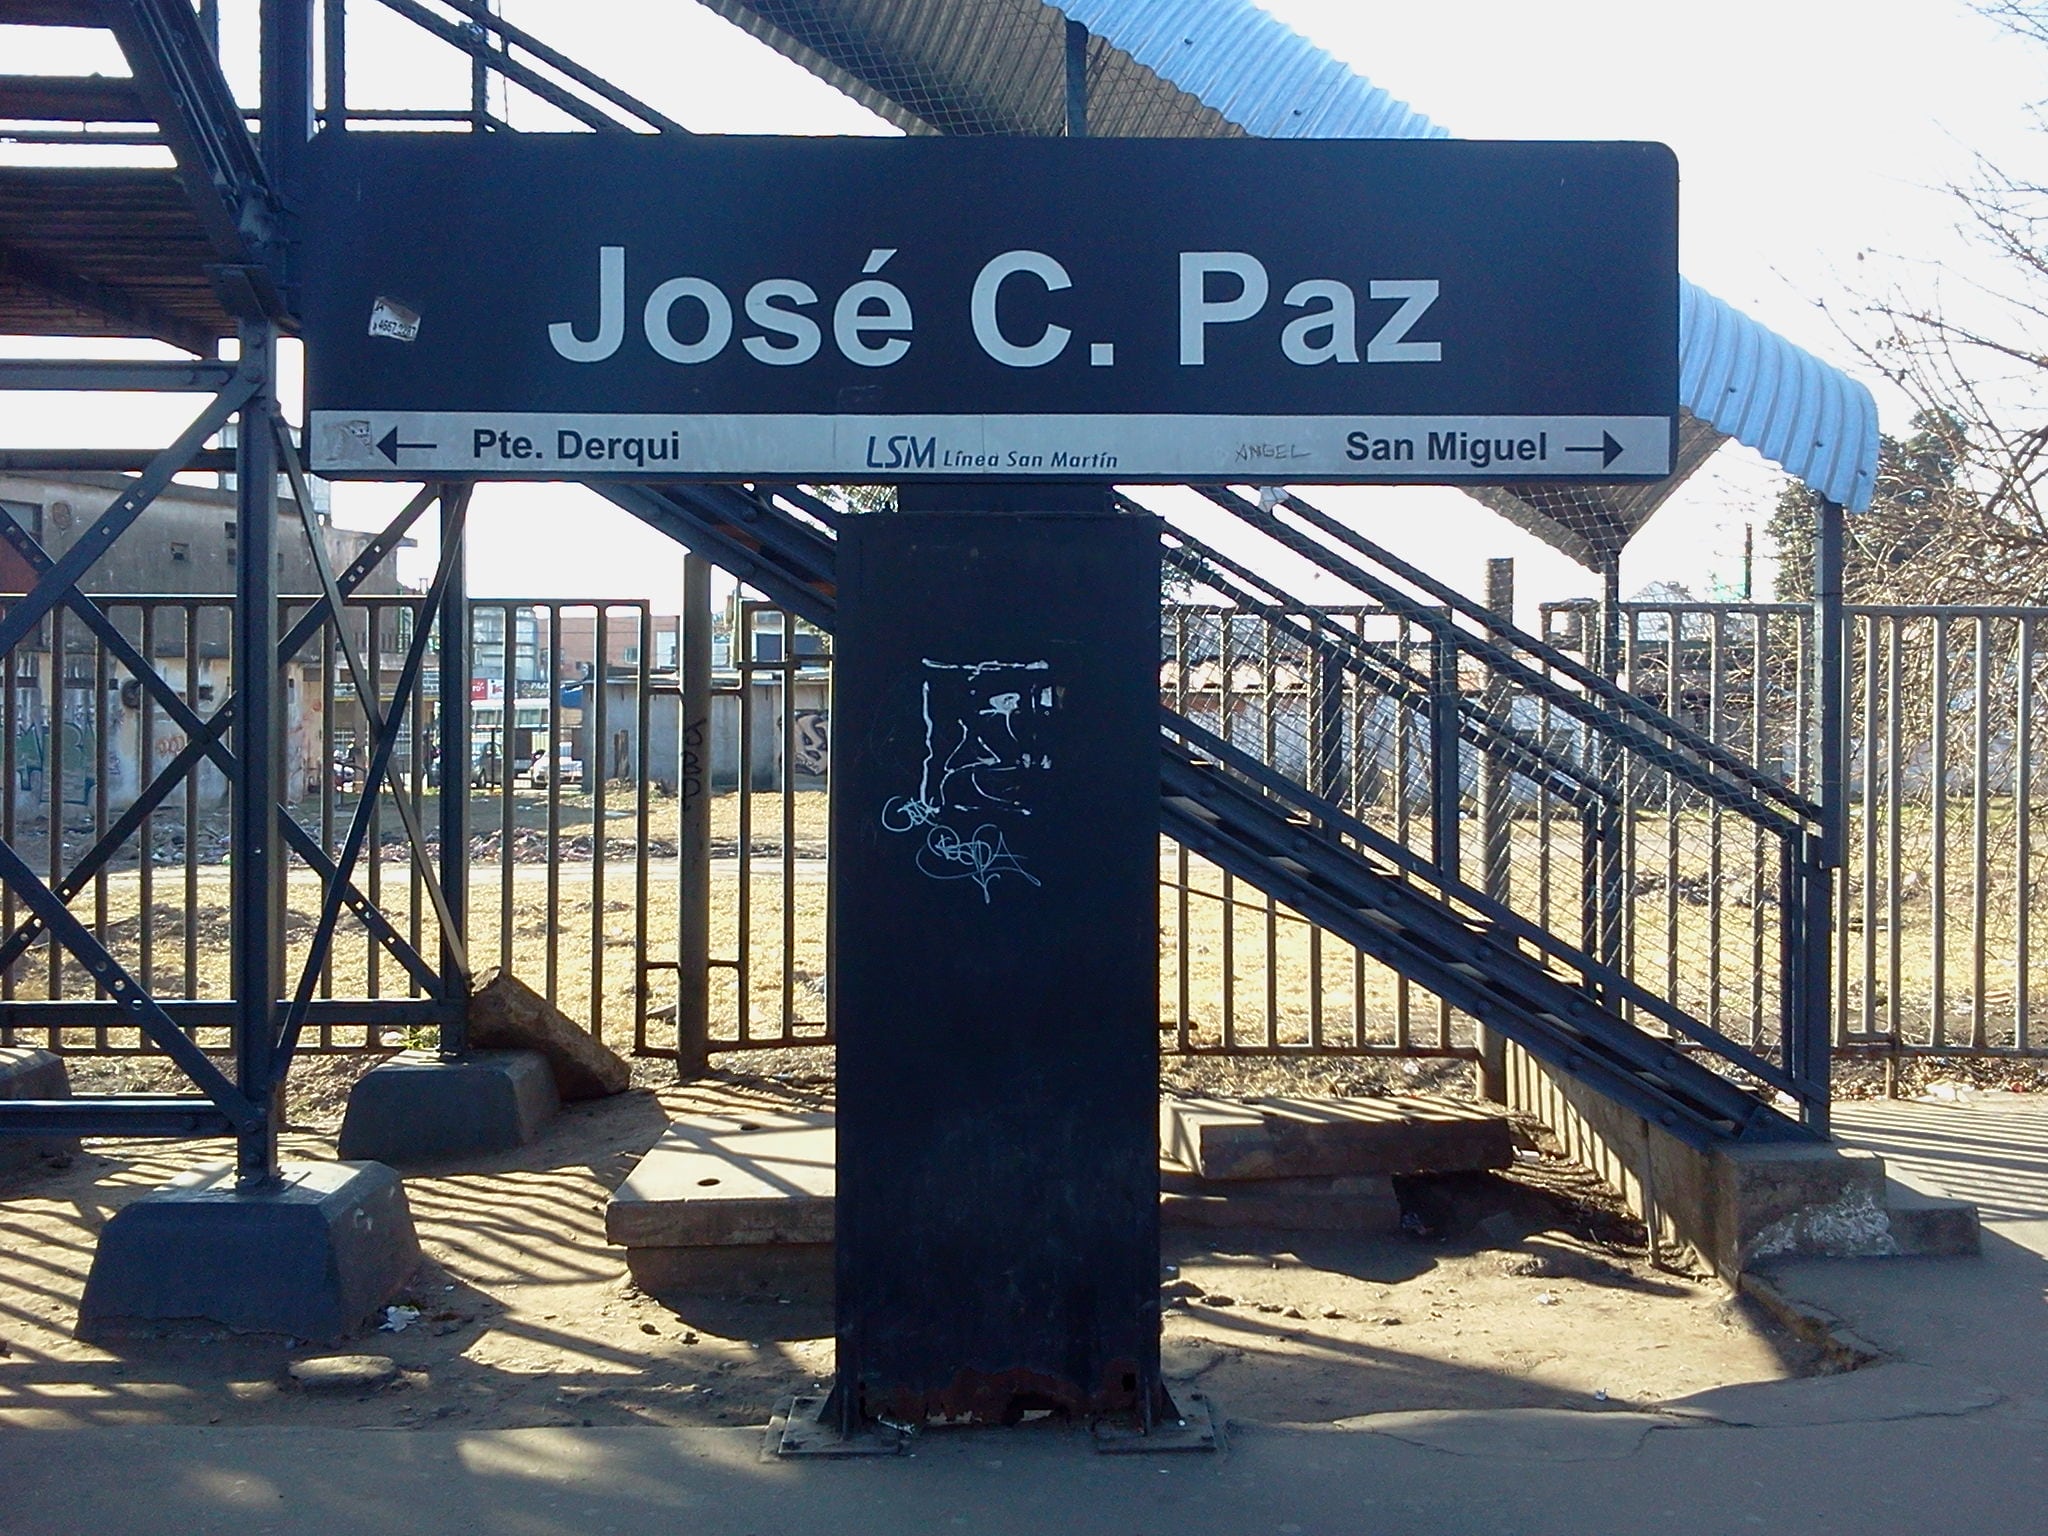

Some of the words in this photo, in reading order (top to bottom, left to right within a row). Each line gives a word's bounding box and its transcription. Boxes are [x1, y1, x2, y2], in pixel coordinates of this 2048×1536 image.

[548, 246, 912, 366] José
[970, 250, 1114, 367] C.
[1179, 252, 1442, 366] Paz
[473, 429, 543, 460] Pte.
[557, 430, 679, 468] Derqui
[866, 435, 937, 469] LSM
[943, 450, 999, 467] Línea
[1006, 450, 1043, 468] San
[1050, 451, 1118, 469] Martín
[1234, 443, 1312, 463] ANGEL
[1345, 431, 1414, 461] San
[1428, 431, 1547, 469] Miguel
